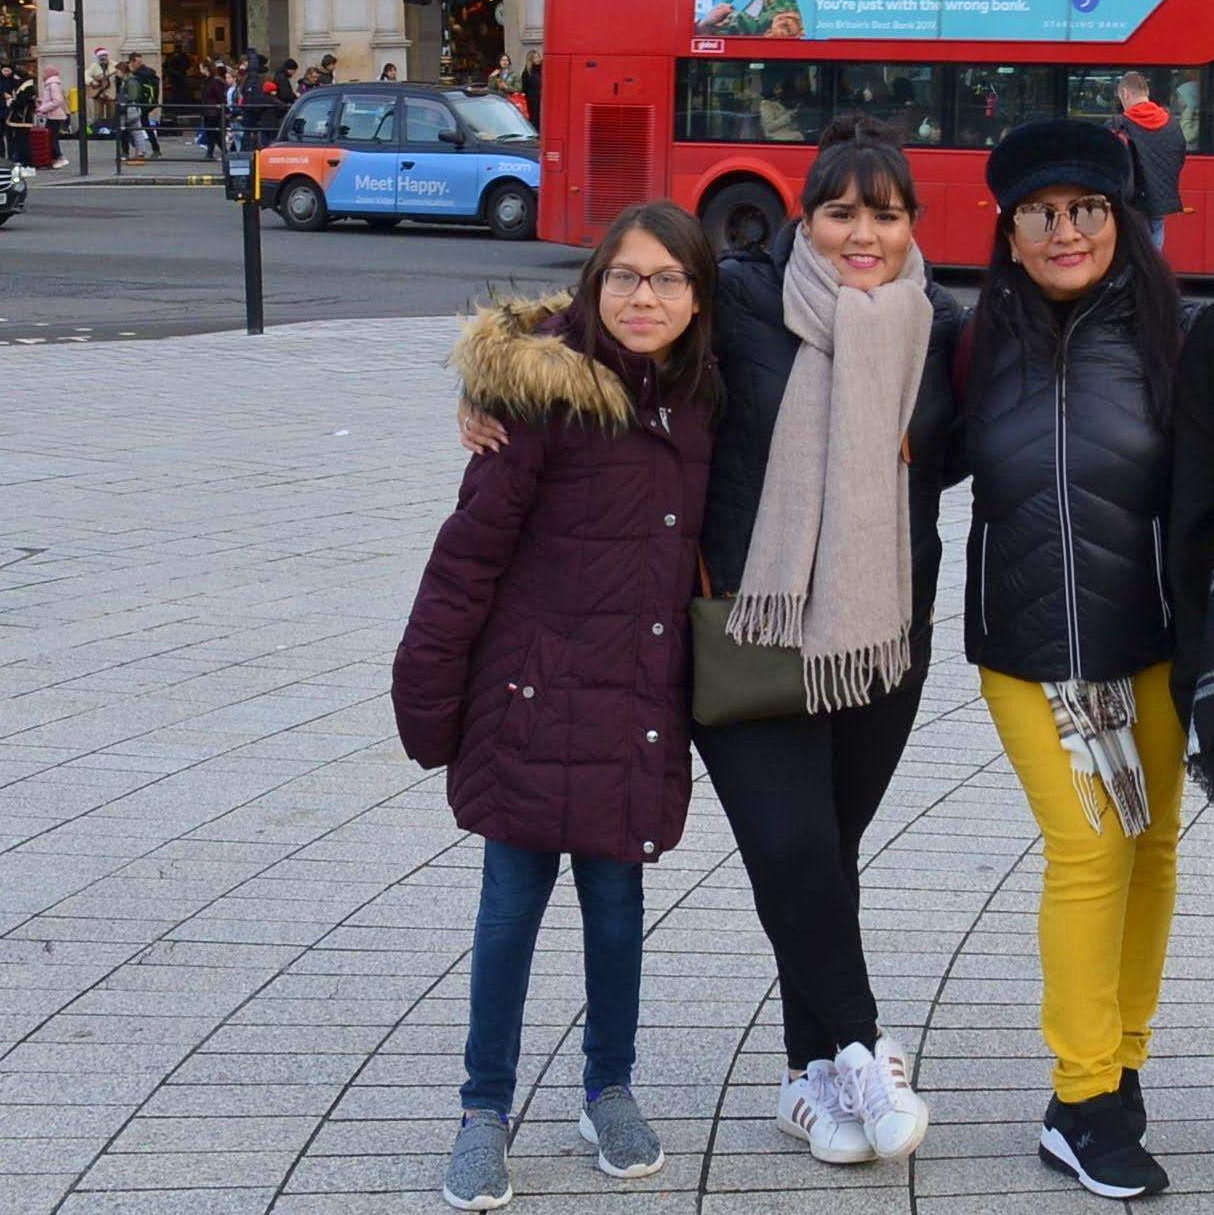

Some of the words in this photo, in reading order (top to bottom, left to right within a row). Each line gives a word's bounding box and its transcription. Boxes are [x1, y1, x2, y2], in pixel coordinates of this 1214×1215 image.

[946, 0, 990, 14] wrong
[497, 161, 533, 173] zoom
[355, 174, 393, 191] Meet
[397, 175, 450, 196] Happy.
